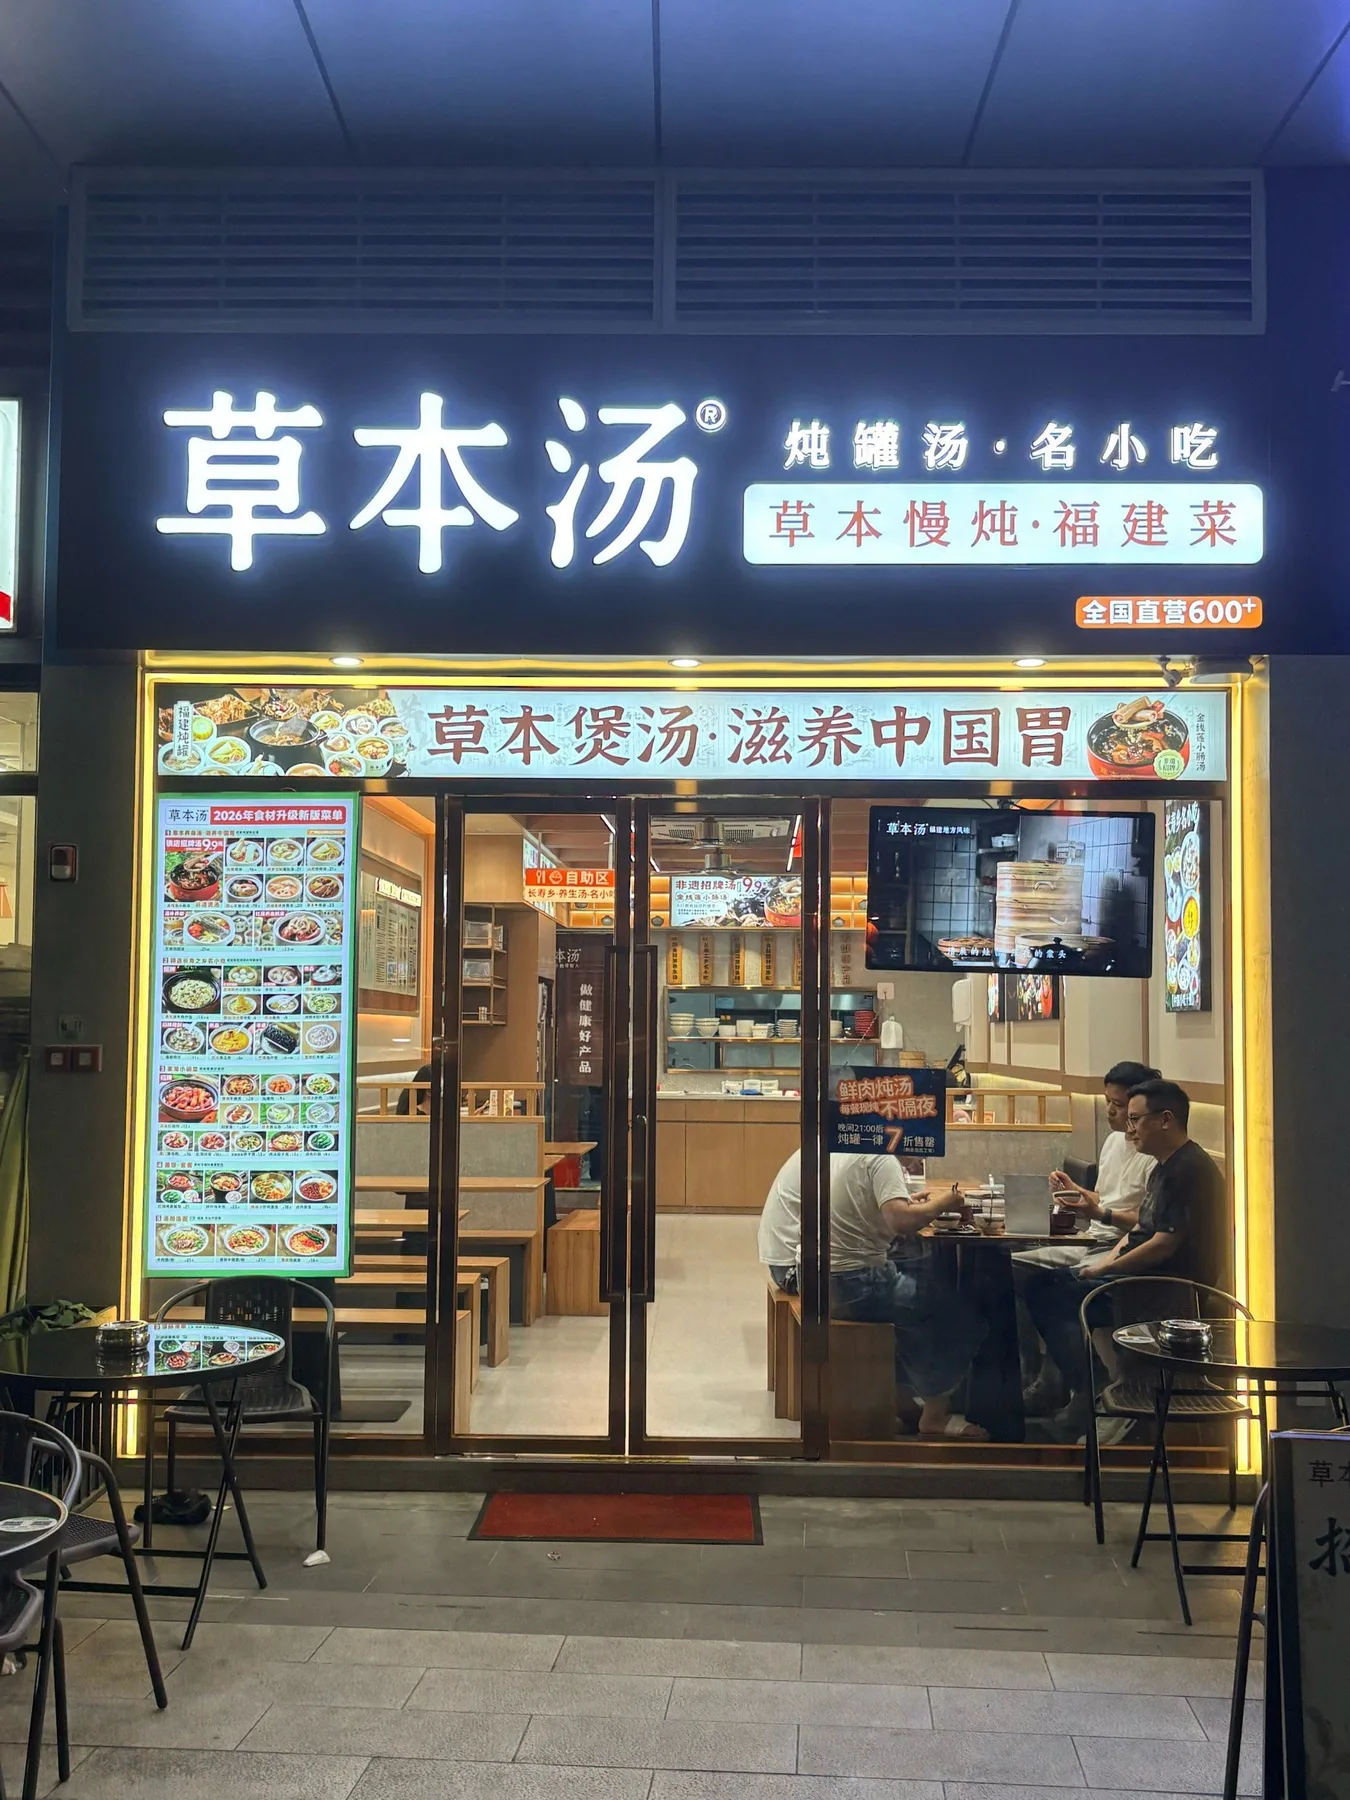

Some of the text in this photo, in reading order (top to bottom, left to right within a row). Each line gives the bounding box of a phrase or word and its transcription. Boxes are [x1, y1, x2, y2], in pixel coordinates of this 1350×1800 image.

[783, 420, 1220, 471] 炖罐汤·名小吃
[156, 390, 699, 574] 草本汤
[768, 499, 1238, 548] 草本慢炖·福建菜
[427, 704, 1073, 769] 草本煲汤·滋养中国胃
[168, 808, 343, 822] 草本汤 2026年食材升级新版菜单
[886, 821, 926, 836] 草本汤
[566, 870, 610, 885] 自助区
[578, 983, 594, 1074] 做健康好产品
[839, 1077, 913, 1101] 鲜肉炖汤
[880, 1096, 936, 1120] 不隔夜
[837, 1123, 884, 1133] 晚间21:00后
